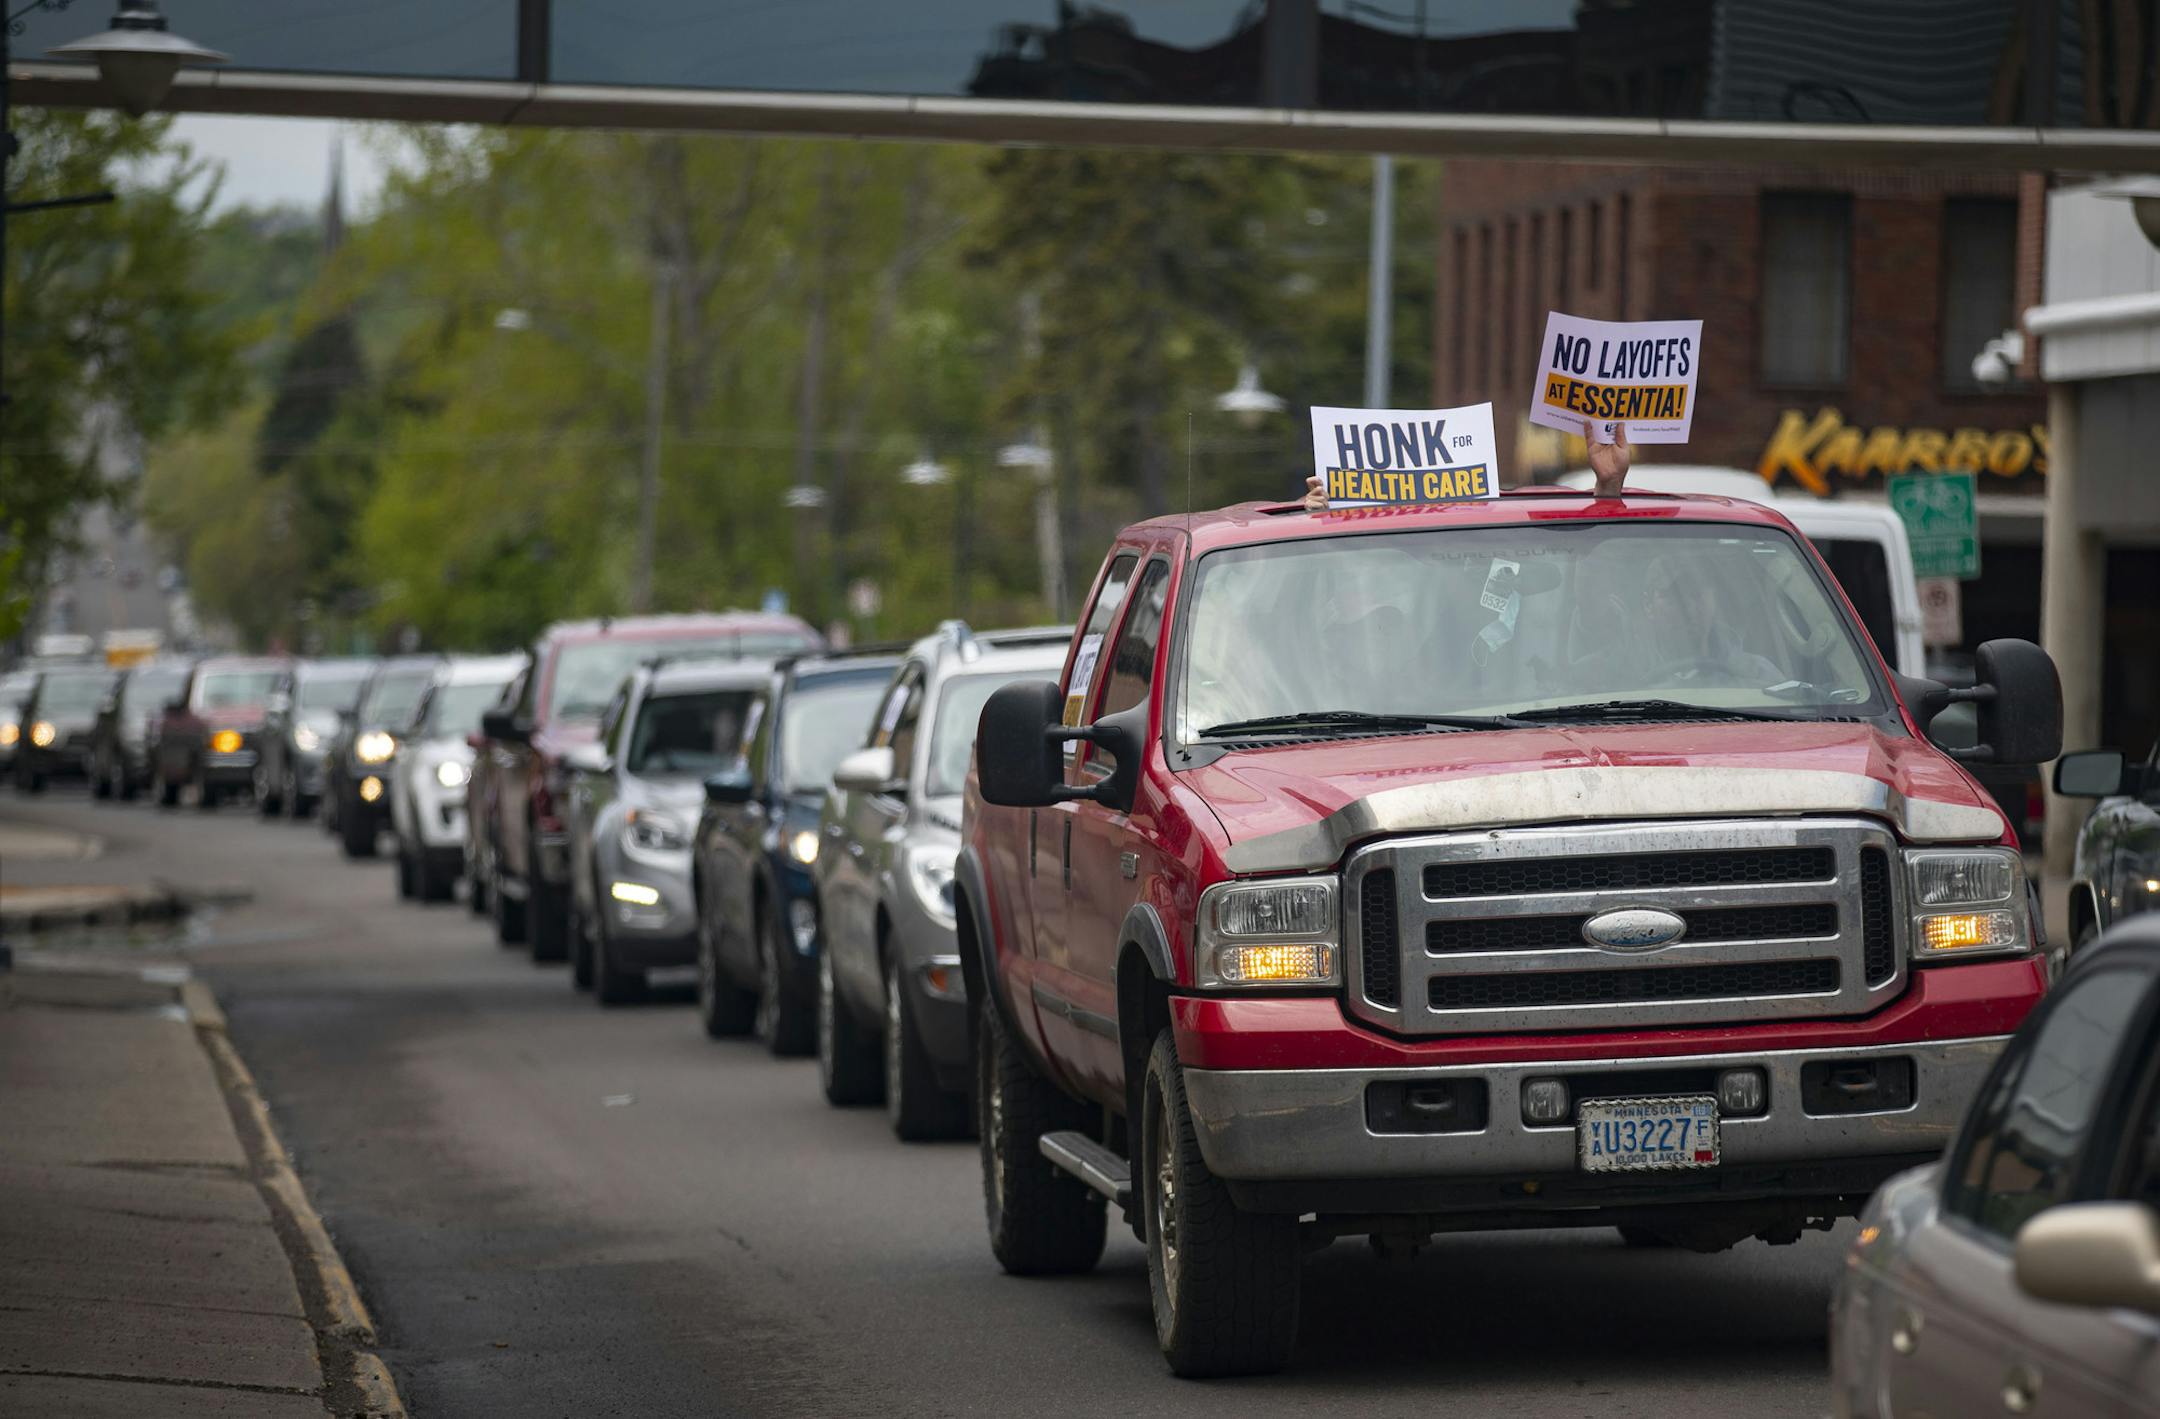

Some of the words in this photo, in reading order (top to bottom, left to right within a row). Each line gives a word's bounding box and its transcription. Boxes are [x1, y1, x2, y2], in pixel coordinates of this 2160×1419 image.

[1552, 333, 1592, 376] NO
[1597, 337, 1691, 379] LAYOFFS
[1548, 383, 1566, 400] AT
[1566, 380, 1685, 418] ESSENTIA!
[1334, 419, 1453, 472] HONK
[1452, 435, 1473, 448] FOR
[1329, 470, 1416, 500] HEALTH
[1423, 467, 1487, 499] CARE
[1614, 1104, 1682, 1118] MINNESOTA
[1652, 1151, 1686, 1164] LAKES
